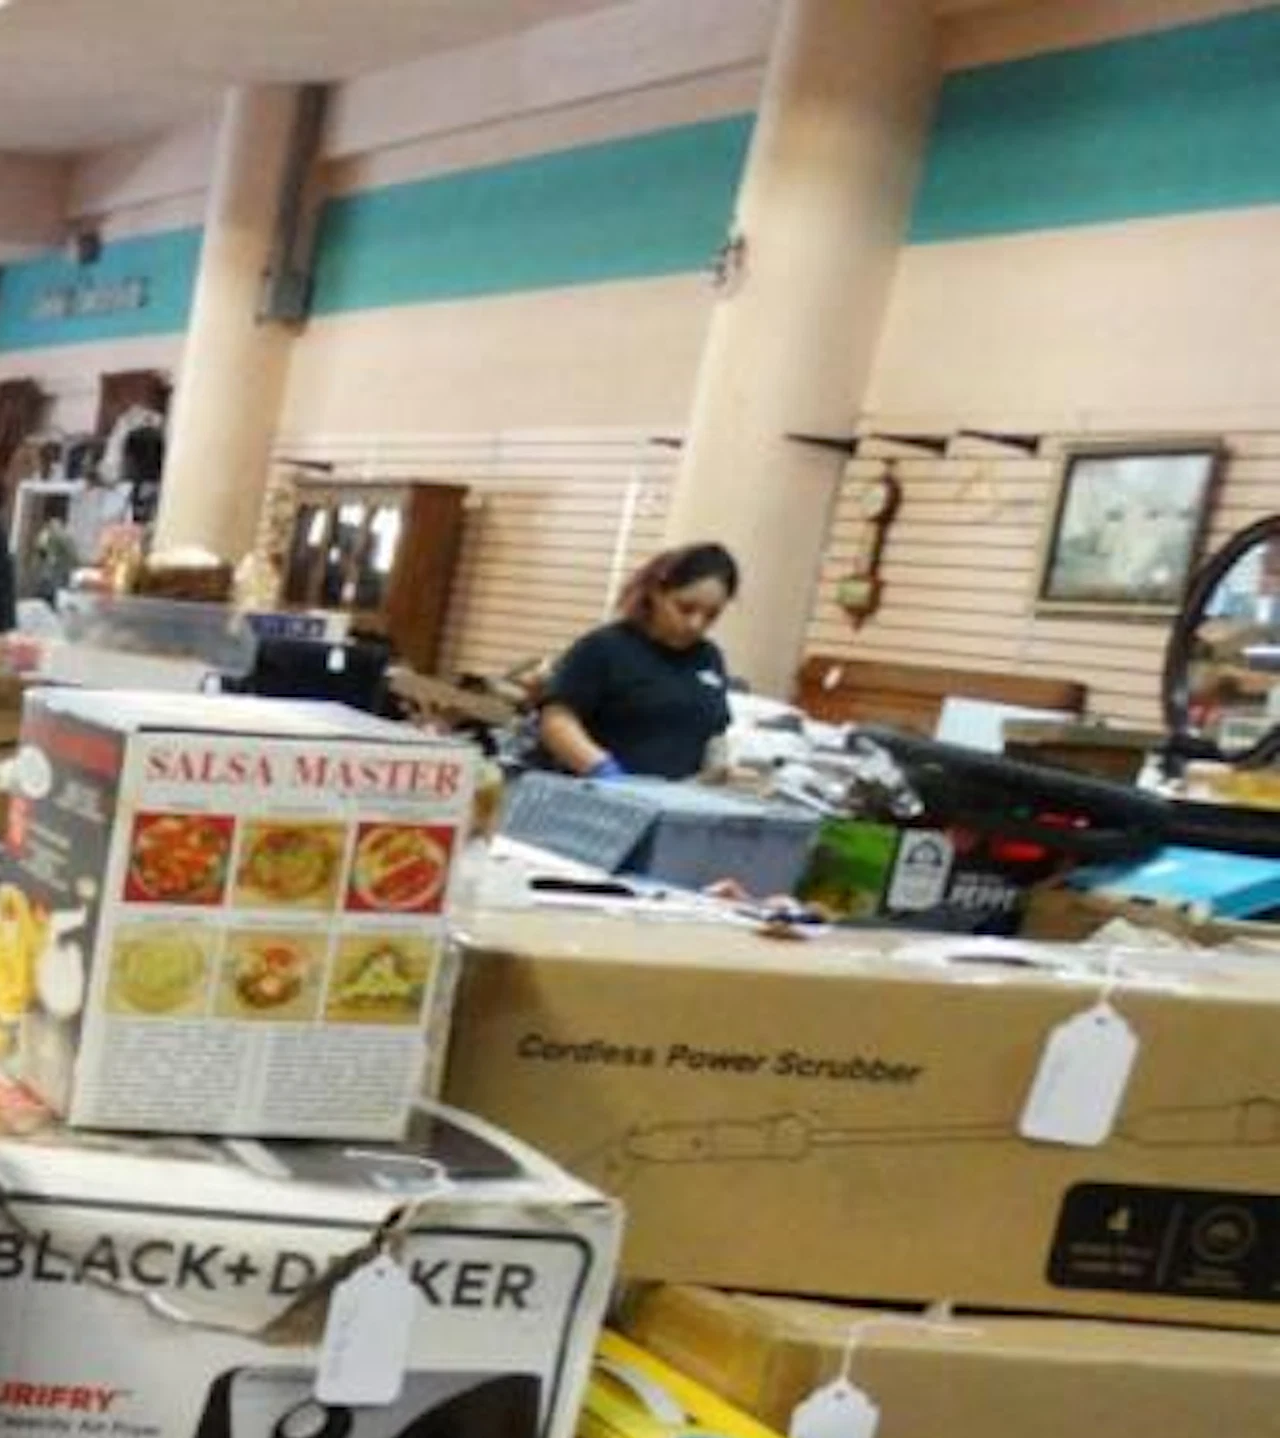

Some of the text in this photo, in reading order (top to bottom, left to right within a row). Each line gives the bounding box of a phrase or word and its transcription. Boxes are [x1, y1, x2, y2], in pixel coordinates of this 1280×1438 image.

[145, 748, 463, 797] SALSA MASTER
[517, 1033, 923, 1084] Cordless Power Scrubber
